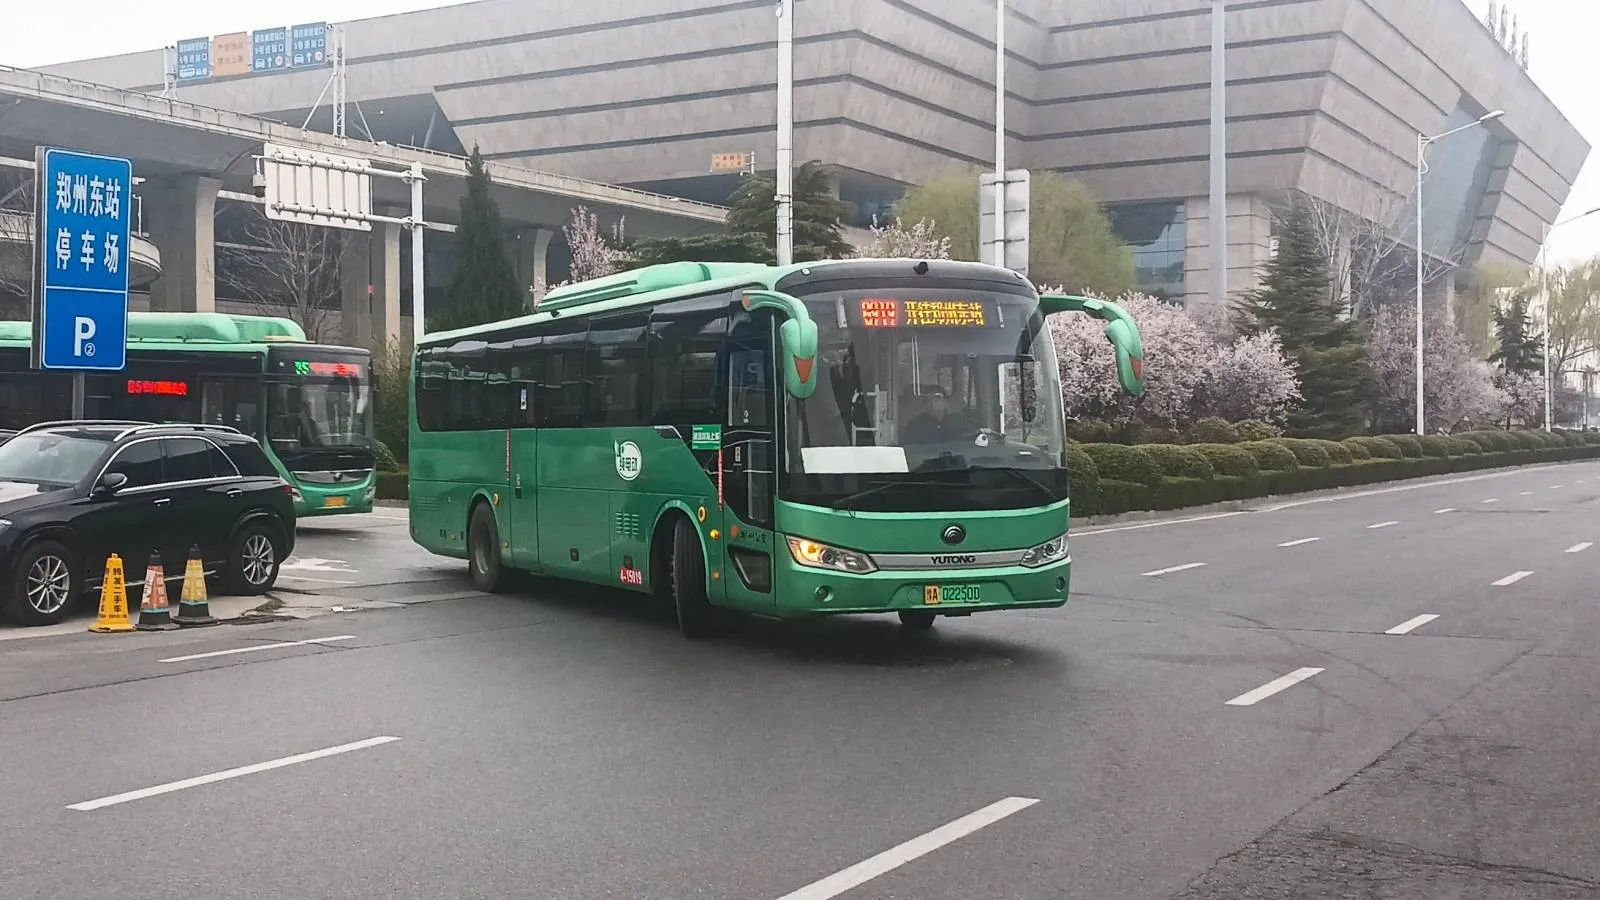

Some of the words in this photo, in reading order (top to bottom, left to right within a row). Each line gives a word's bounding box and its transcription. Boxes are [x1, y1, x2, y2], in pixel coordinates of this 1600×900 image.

[55, 171, 121, 220] 郑州东站
[55, 227, 120, 273] 停车场
[74, 316, 96, 356] P
[930, 555, 976, 565] YUTONG
